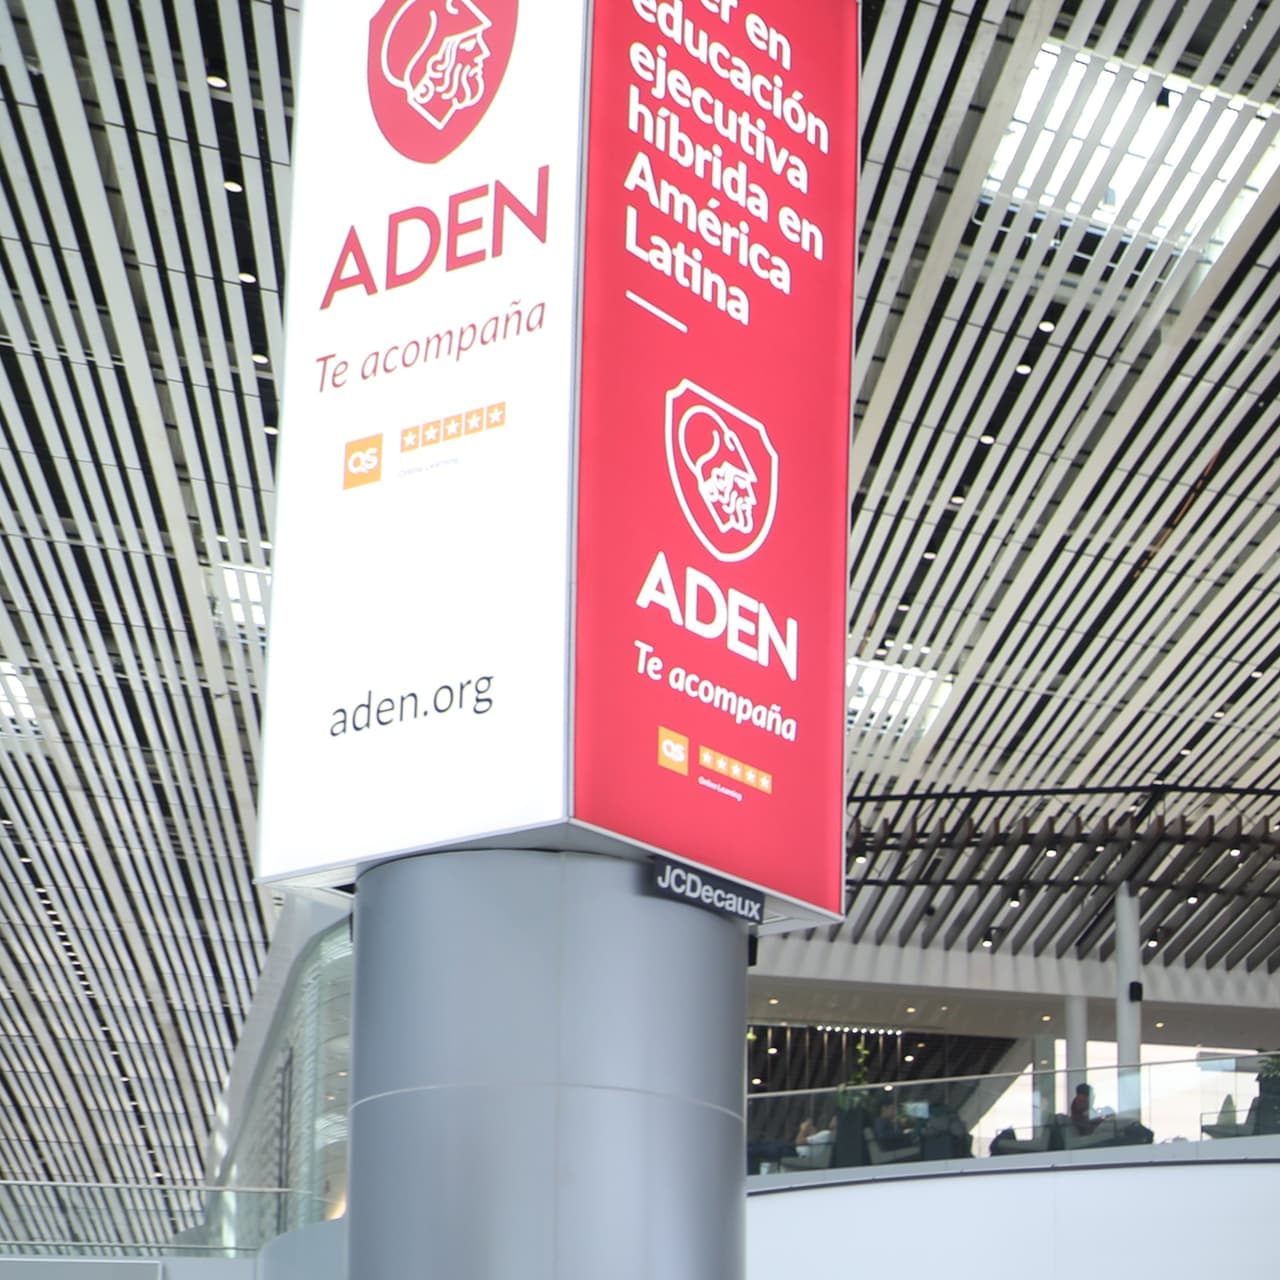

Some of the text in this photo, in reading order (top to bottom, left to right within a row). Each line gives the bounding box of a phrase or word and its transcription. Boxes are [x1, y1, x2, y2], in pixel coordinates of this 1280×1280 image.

[632, 0, 829, 154] educación
[745, 13, 792, 71] en
[628, 84, 824, 262] híbrida en
[629, 41, 809, 195] ejecutiva
[320, 164, 551, 312] ADEN
[624, 151, 791, 295] América
[625, 204, 750, 327] Latina
[314, 299, 548, 394] Te acompaña
[348, 447, 379, 475] QS
[636, 551, 798, 681] ADEN
[329, 675, 496, 740] aden.org
[634, 640, 797, 743] Te acompaña
[662, 739, 685, 762] QS
[657, 865, 763, 922] JCDecaux
